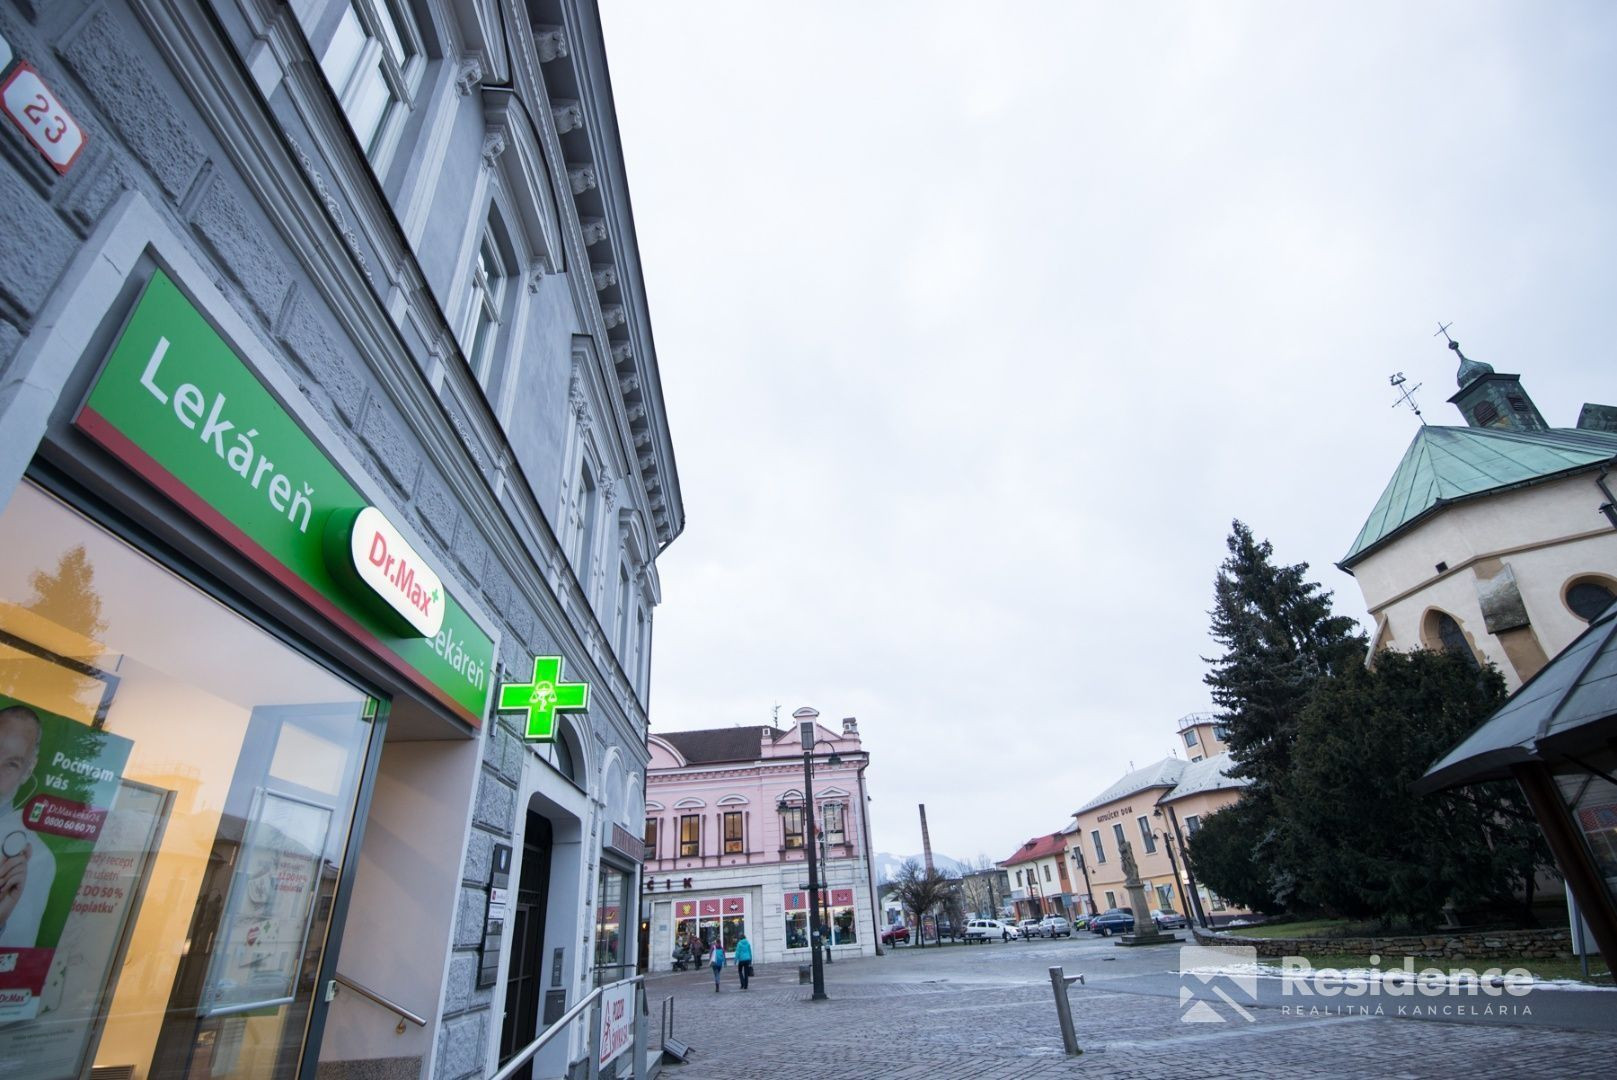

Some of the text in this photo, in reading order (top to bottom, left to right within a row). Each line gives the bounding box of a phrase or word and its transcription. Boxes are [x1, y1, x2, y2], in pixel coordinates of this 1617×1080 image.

[23, 93, 67, 144] 23
[139, 335, 315, 534] Lekáreň
[368, 531, 432, 617] Dr.Max
[45, 773, 69, 791] vás
[52, 751, 114, 782] Počúvam
[82, 885, 100, 897] DO
[101, 886, 113, 898] 50
